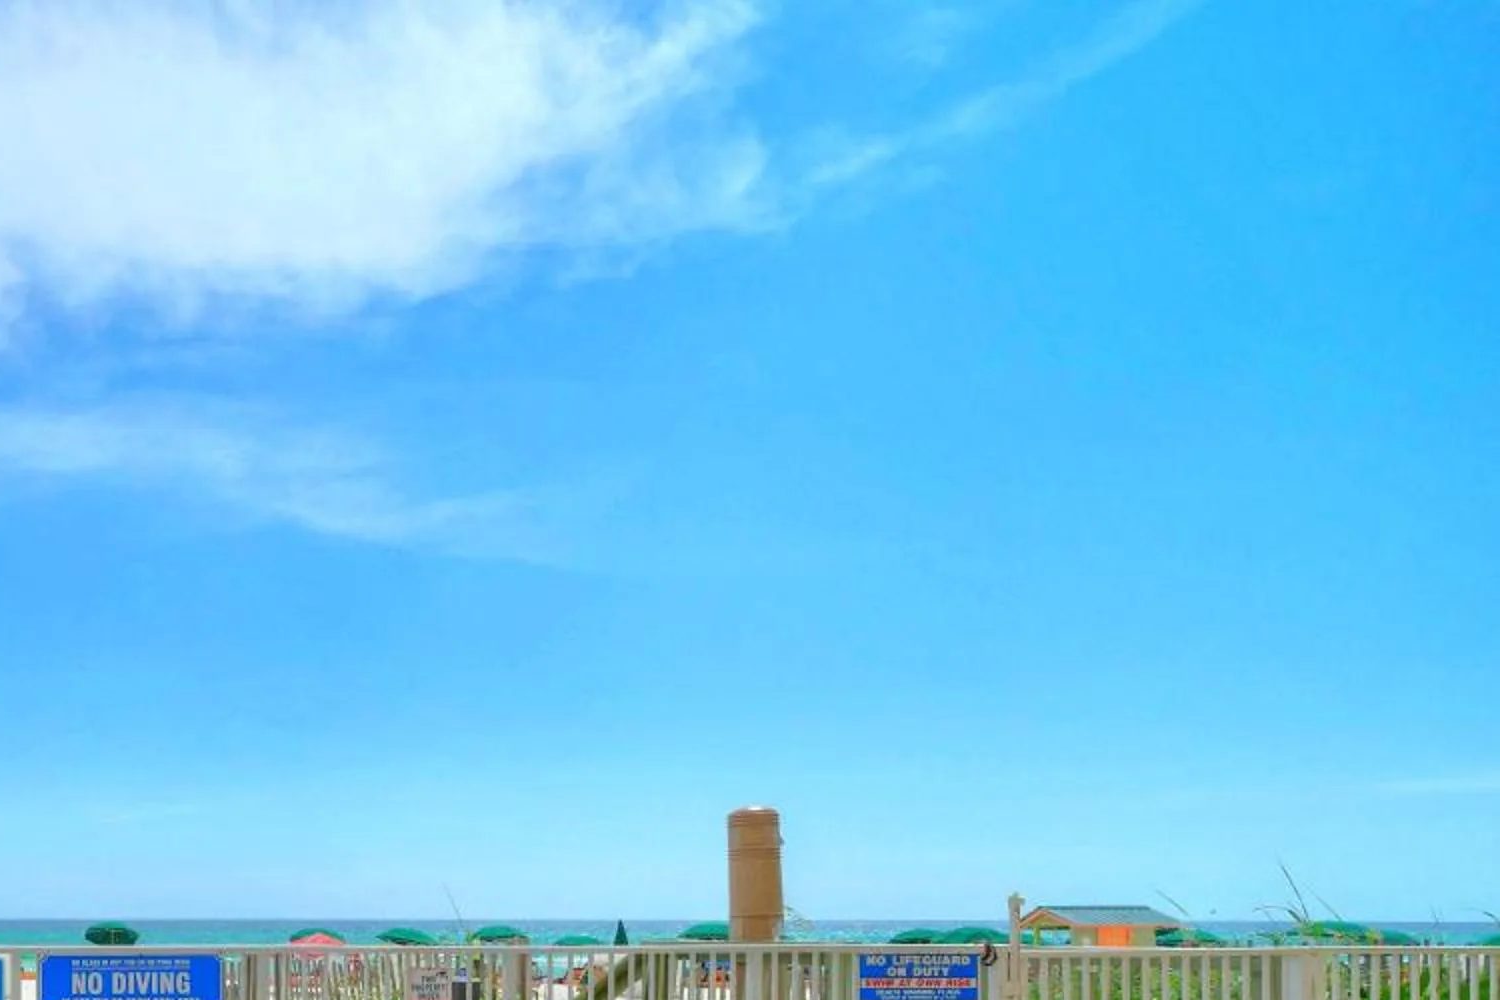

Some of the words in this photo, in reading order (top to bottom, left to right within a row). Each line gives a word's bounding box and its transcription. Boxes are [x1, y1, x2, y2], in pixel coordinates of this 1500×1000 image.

[866, 956, 886, 966] NO
[892, 955, 971, 965] LIFEGUARD
[887, 966, 906, 976] ON
[913, 966, 949, 976] DUTY
[71, 971, 103, 995] NO
[111, 971, 191, 995] DIVING
